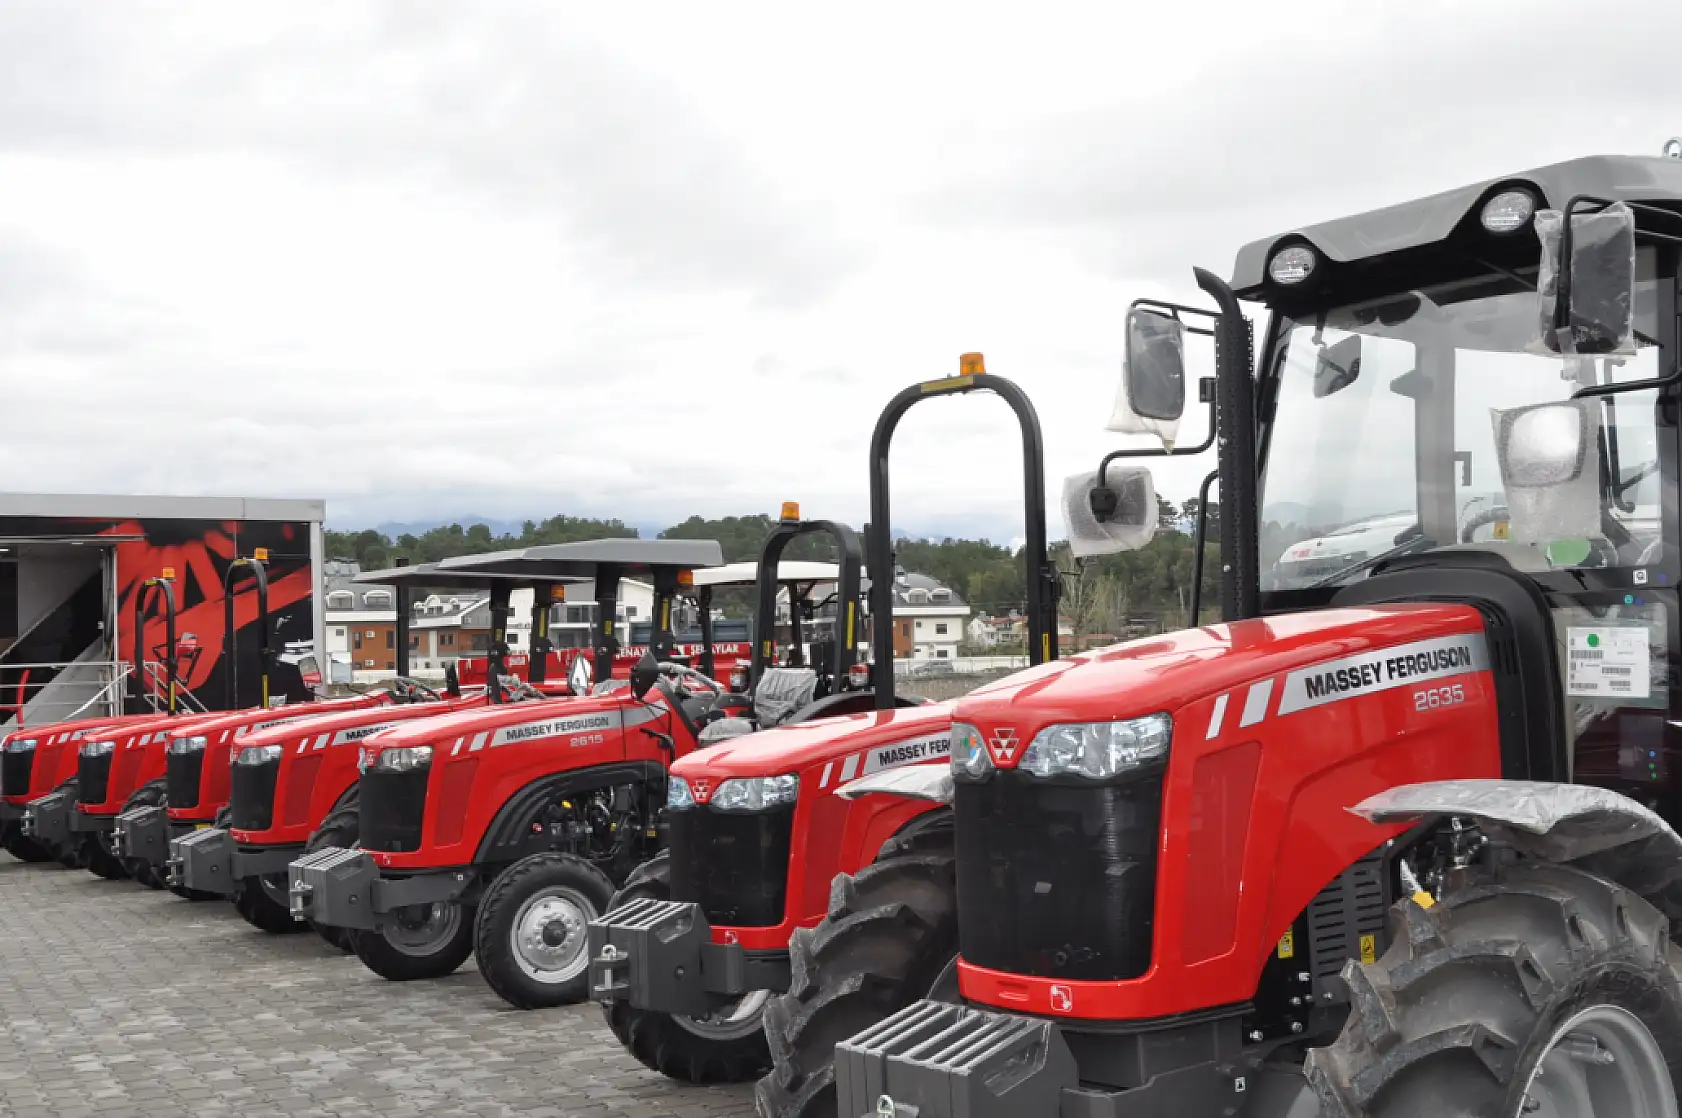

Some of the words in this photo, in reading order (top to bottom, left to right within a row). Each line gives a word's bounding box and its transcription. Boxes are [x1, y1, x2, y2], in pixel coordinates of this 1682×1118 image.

[1304, 661, 1382, 699] MASSEY
[1386, 646, 1472, 680] FERGUSON
[1413, 684, 1465, 712] 2635
[506, 724, 552, 741] MASSEY
[555, 716, 609, 733] FERGUSON
[570, 734, 604, 747] 2615
[878, 742, 927, 766] MASSEY
[928, 738, 951, 754] FER
